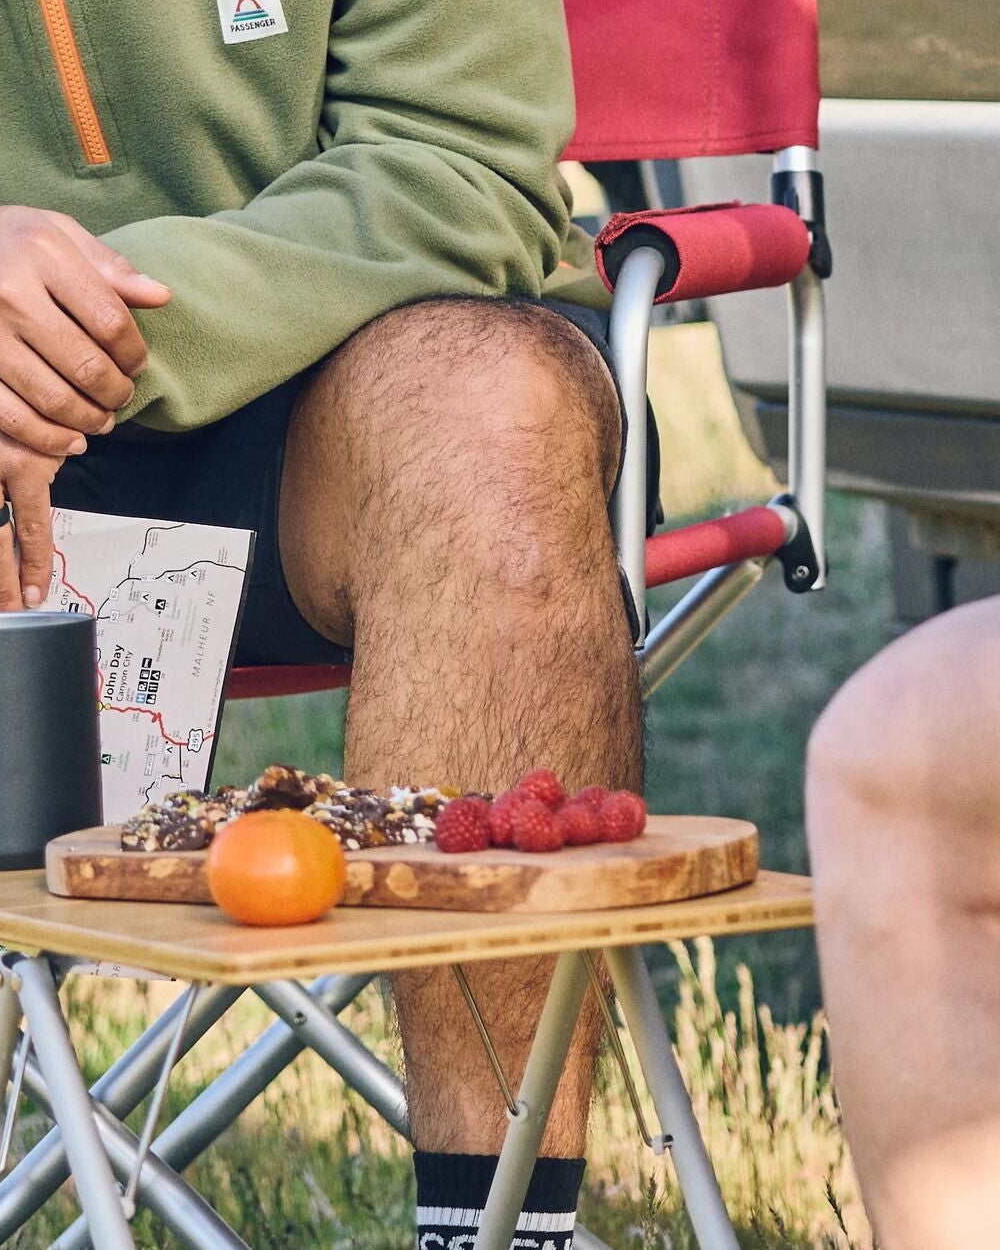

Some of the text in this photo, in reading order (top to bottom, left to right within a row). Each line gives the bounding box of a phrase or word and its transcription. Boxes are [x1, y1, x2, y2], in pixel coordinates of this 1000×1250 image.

[230, 18, 276, 33] PASSENGER
[60, 588, 71, 606] City
[111, 589, 117, 598] 62
[191, 590, 215, 677] MALHEUR NF
[103, 643, 124, 700] John Day
[115, 650, 133, 702] Canyon City
[190, 732, 200, 748] 395
